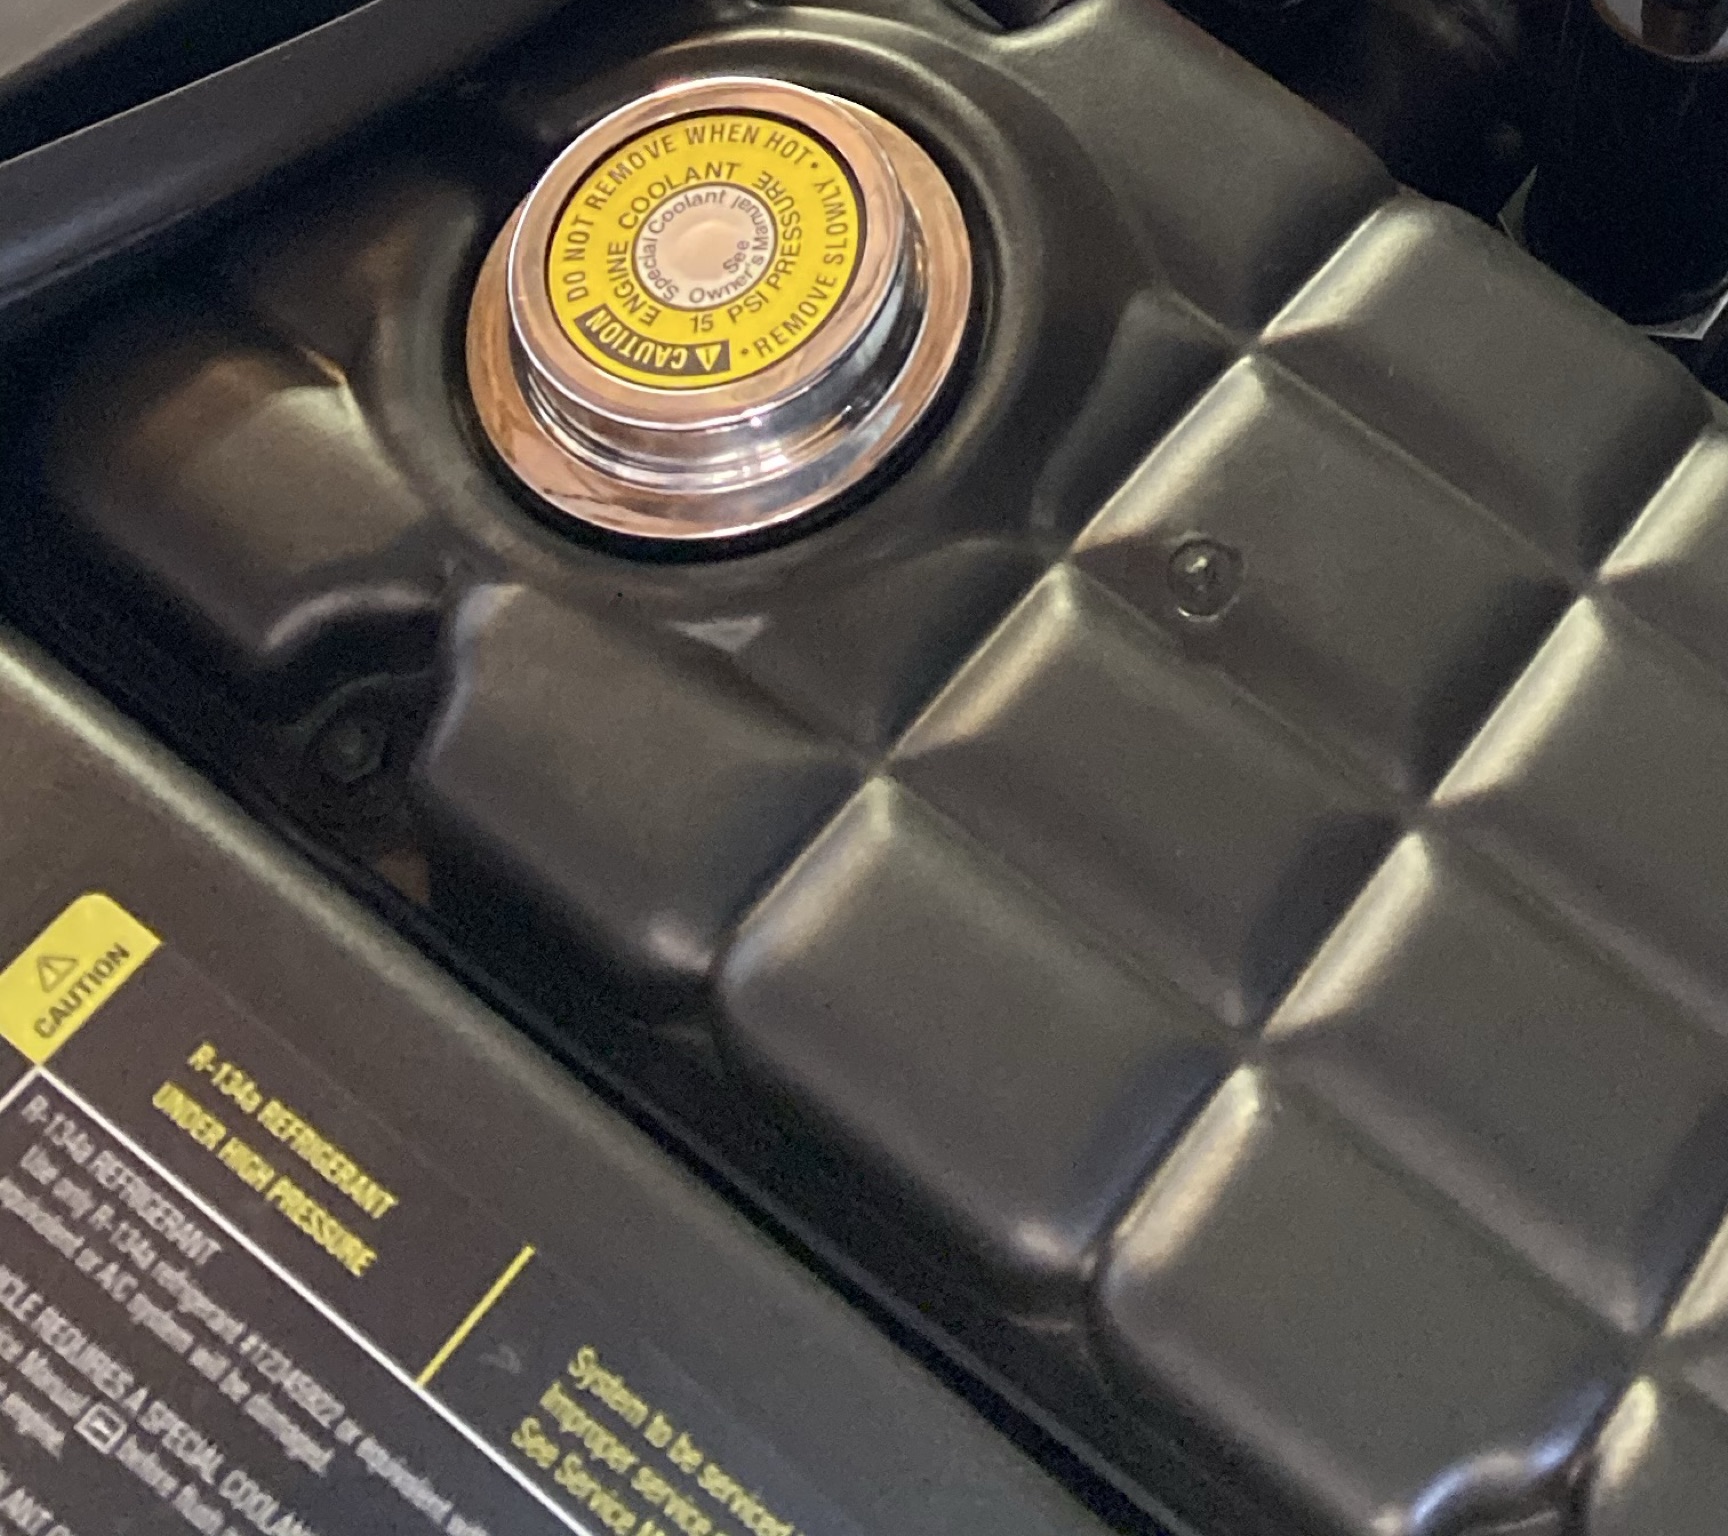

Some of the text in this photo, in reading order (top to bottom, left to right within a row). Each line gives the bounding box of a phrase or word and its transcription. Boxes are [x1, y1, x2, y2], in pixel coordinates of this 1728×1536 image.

[562, 123, 813, 304] DO NOT REMOVE WHEN HOT
[606, 160, 742, 328] ENGINE COOLANT
[637, 188, 728, 304] Special Coolant
[688, 194, 771, 305] Owner's Manual
[689, 170, 803, 335] 15 PSI PRESSURE
[722, 238, 751, 275] See
[753, 177, 850, 360] REMOVE SLOWLY
[584, 308, 689, 370] CAUTION
[33, 941, 131, 1040] CAUTION
[87, 1148, 223, 1266] REFRIGERANT
[151, 1081, 379, 1278] UNDER HIGH PRESSURE
[257, 1098, 399, 1220] REFRIGERANT
[31, 1304, 136, 1401] REQUIRES
[122, 1384, 150, 1415] A
[136, 1397, 225, 1486] SPECIAL
[511, 1416, 561, 1470] See
[567, 1343, 650, 1429] System
